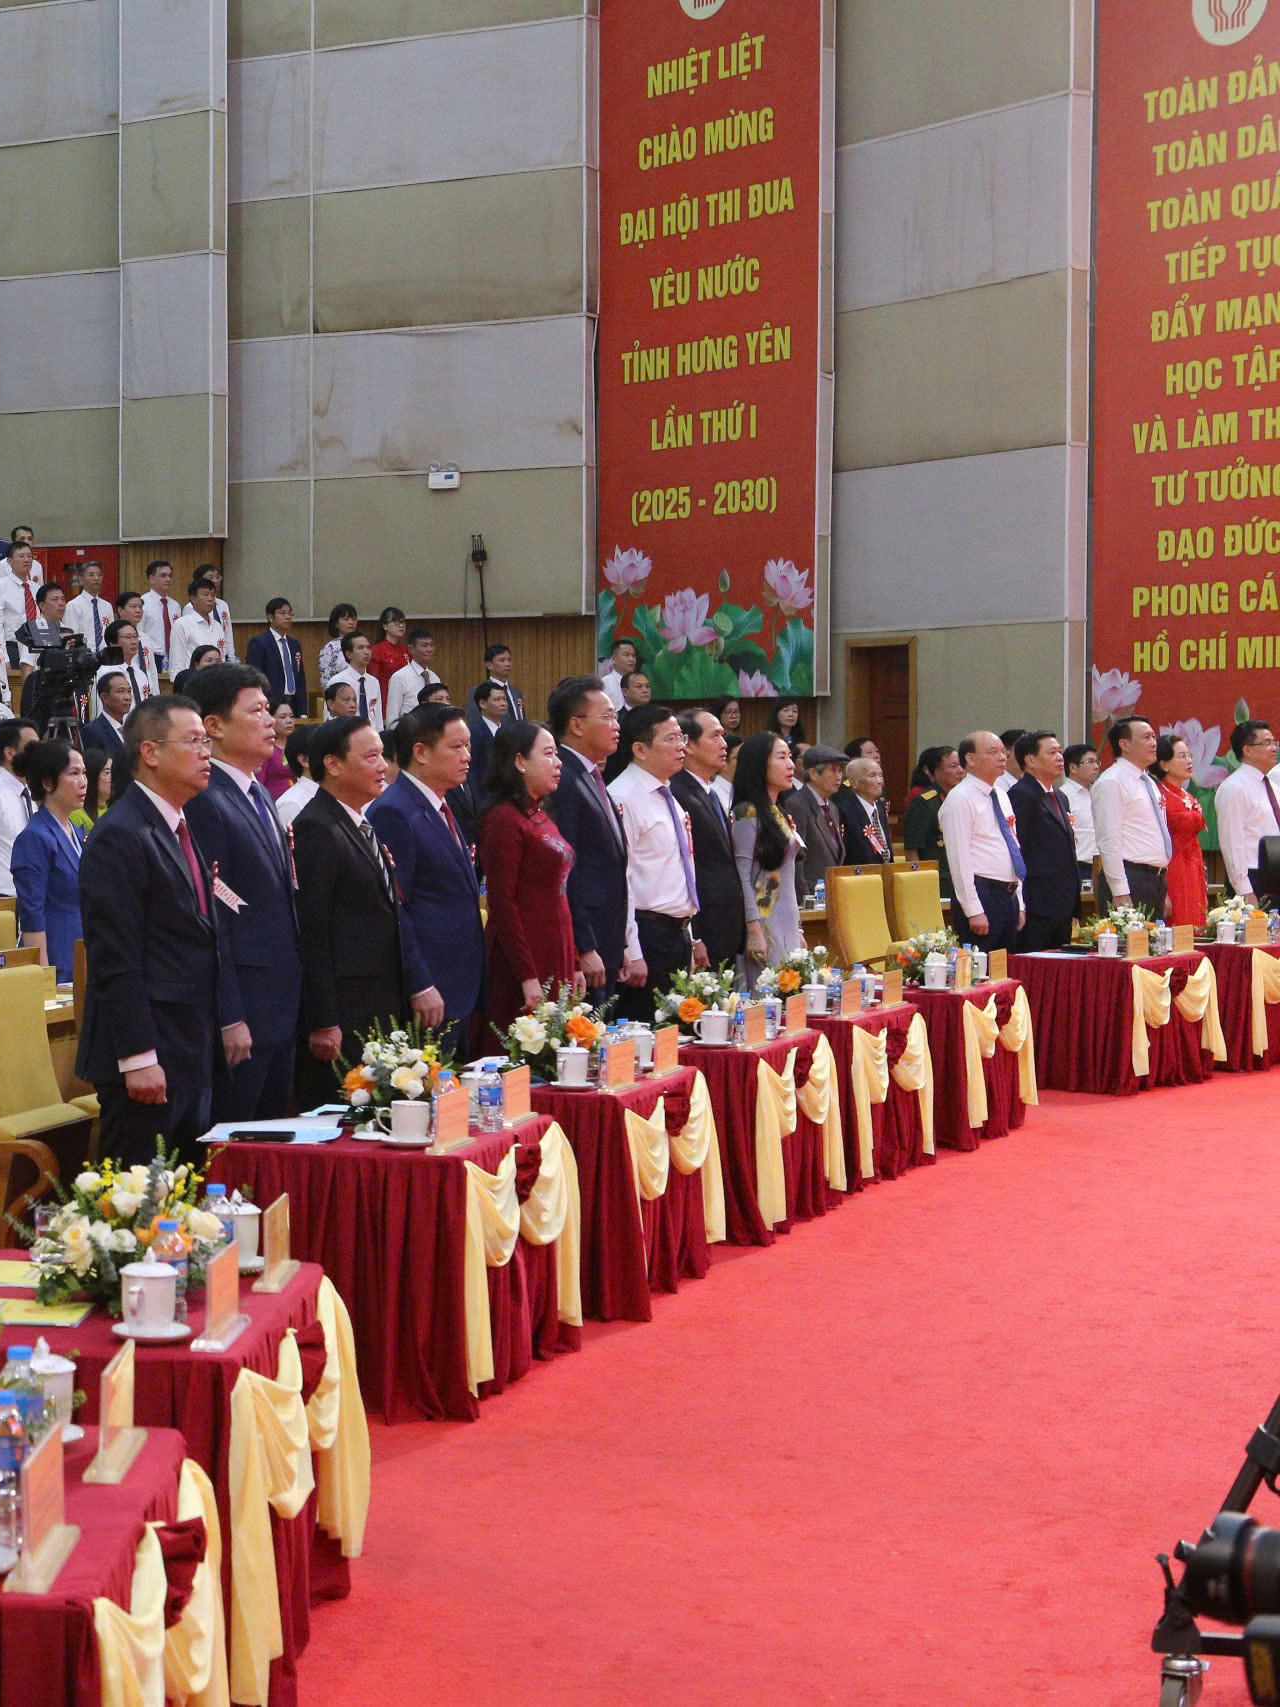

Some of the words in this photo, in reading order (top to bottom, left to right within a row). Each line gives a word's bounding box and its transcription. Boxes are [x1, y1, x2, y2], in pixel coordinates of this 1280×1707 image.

[647, 47, 712, 99] NHIỆT
[718, 31, 765, 81] LIỆT
[1143, 75, 1219, 124] TOÀN
[638, 123, 697, 171] CHÀO
[704, 107, 774, 156] MỪNG
[1152, 130, 1228, 177] TOÀN
[1237, 113, 1280, 160] DÂ
[619, 207, 655, 249] ĐẠI
[662, 192, 699, 241] HỘI
[705, 188, 741, 228] THI
[748, 176, 795, 219] ĐUA
[1146, 187, 1221, 233] TOÀN
[649, 267, 690, 309] YÊU
[697, 253, 760, 301] NƯỚC
[1164, 236, 1227, 286] TIẾP
[1150, 292, 1207, 343] ĐẨY
[1216, 291, 1280, 336] MẠN
[621, 339, 670, 385] TỈNH
[677, 334, 738, 377] HƯNG
[745, 321, 791, 365] YÊN
[1165, 357, 1223, 400] HỌC
[1232, 344, 1280, 392] TẬP
[651, 404, 693, 451] LẦN
[699, 399, 745, 445] THỨ
[749, 404, 757, 439] I
[1132, 413, 1168, 454] VÀ
[1177, 407, 1239, 450] LÀM
[631, 486, 691, 527] (2025
[713, 476, 777, 515] 2030)
[1152, 470, 1189, 507] TƯ
[1157, 526, 1215, 567] ĐẠO
[1224, 515, 1280, 557] ĐỨC
[1132, 581, 1229, 618] PHONG
[1239, 571, 1279, 612] CÁ
[1133, 629, 1170, 673] HỒ
[1179, 630, 1226, 671] CHÍ
[1237, 635, 1280, 669] MI
